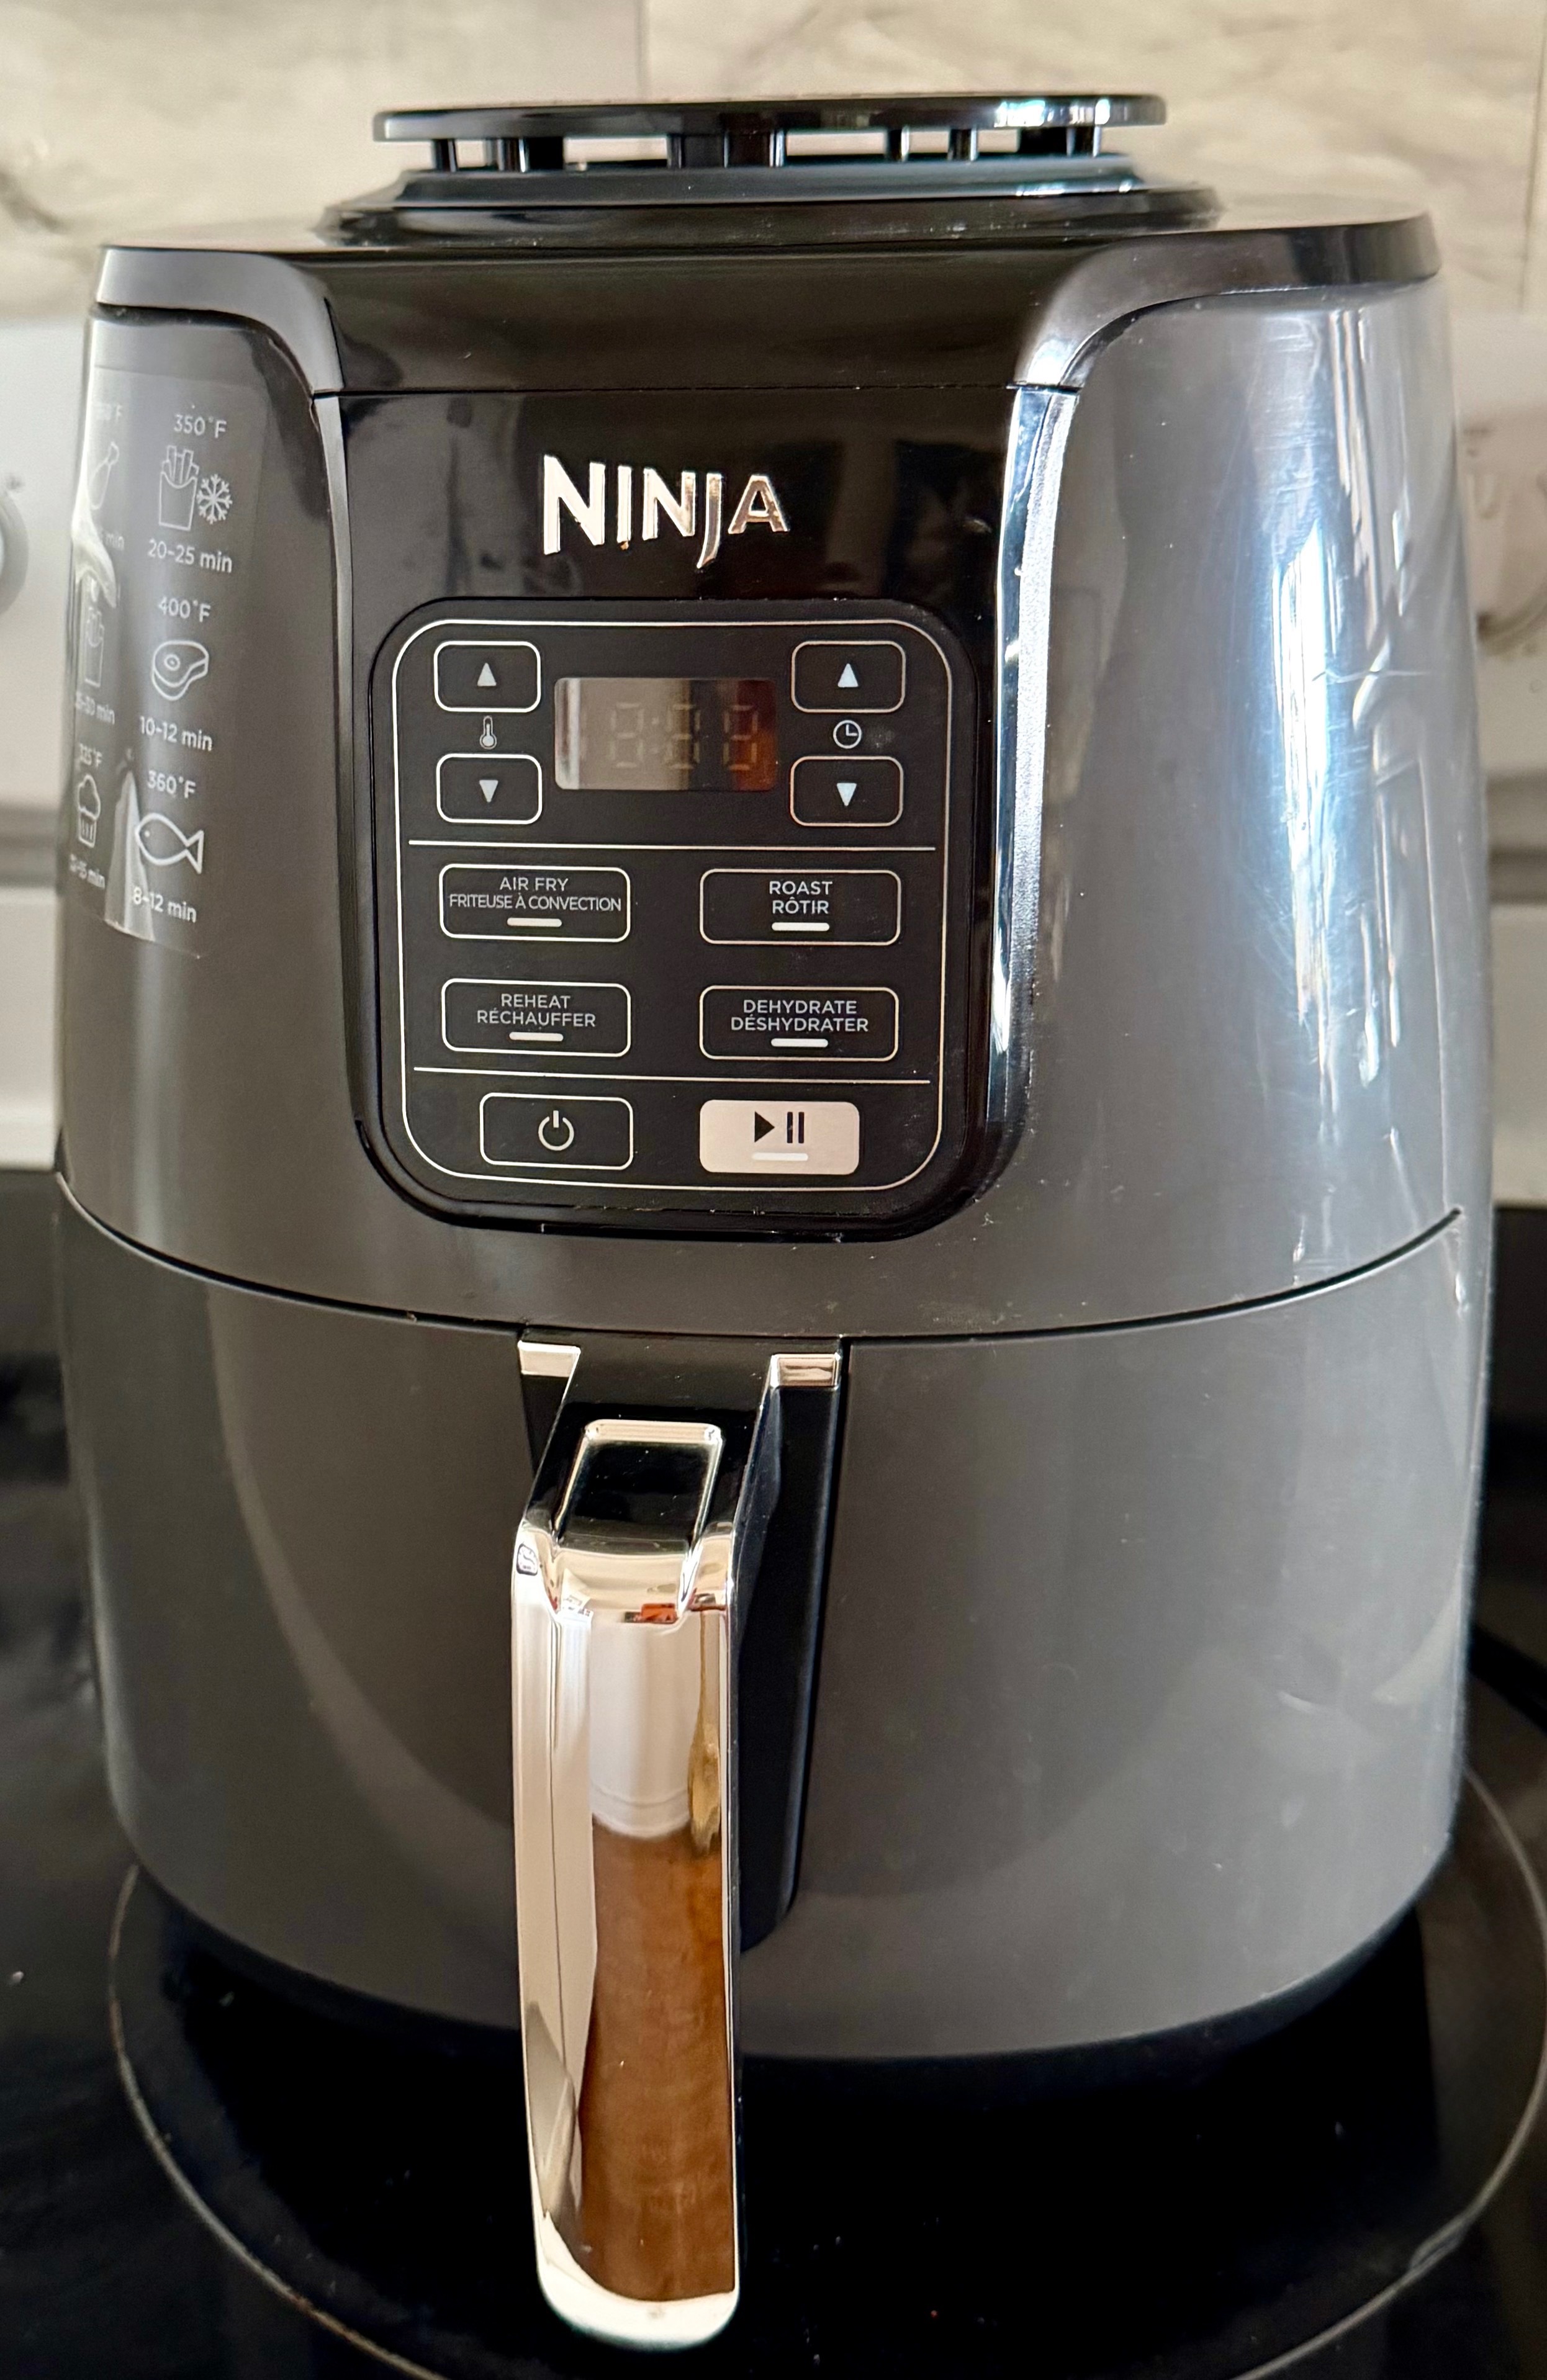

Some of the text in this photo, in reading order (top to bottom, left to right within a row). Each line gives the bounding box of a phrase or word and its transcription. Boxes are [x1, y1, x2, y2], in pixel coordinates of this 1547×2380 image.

[173, 414, 227, 438] 350°F
[543, 454, 790, 569] NINJA
[148, 539, 232, 573] 20-25 min
[158, 596, 211, 622] 400°F
[139, 715, 213, 752] 10-12 min
[147, 770, 196, 799] 360°F
[499, 876, 569, 892] AIR FRY
[769, 881, 833, 896] ROAST
[132, 887, 197, 923] 8-12 min
[449, 892, 621, 912] FRITEUSE À CONVECTION
[772, 896, 829, 915] RÔTIR
[500, 993, 571, 1010] REHEAT
[742, 999, 857, 1015] DEHYDRATE
[477, 1007, 596, 1028] RÉCHAUFFER
[730, 1013, 869, 1032] DÉSHYDRATER
